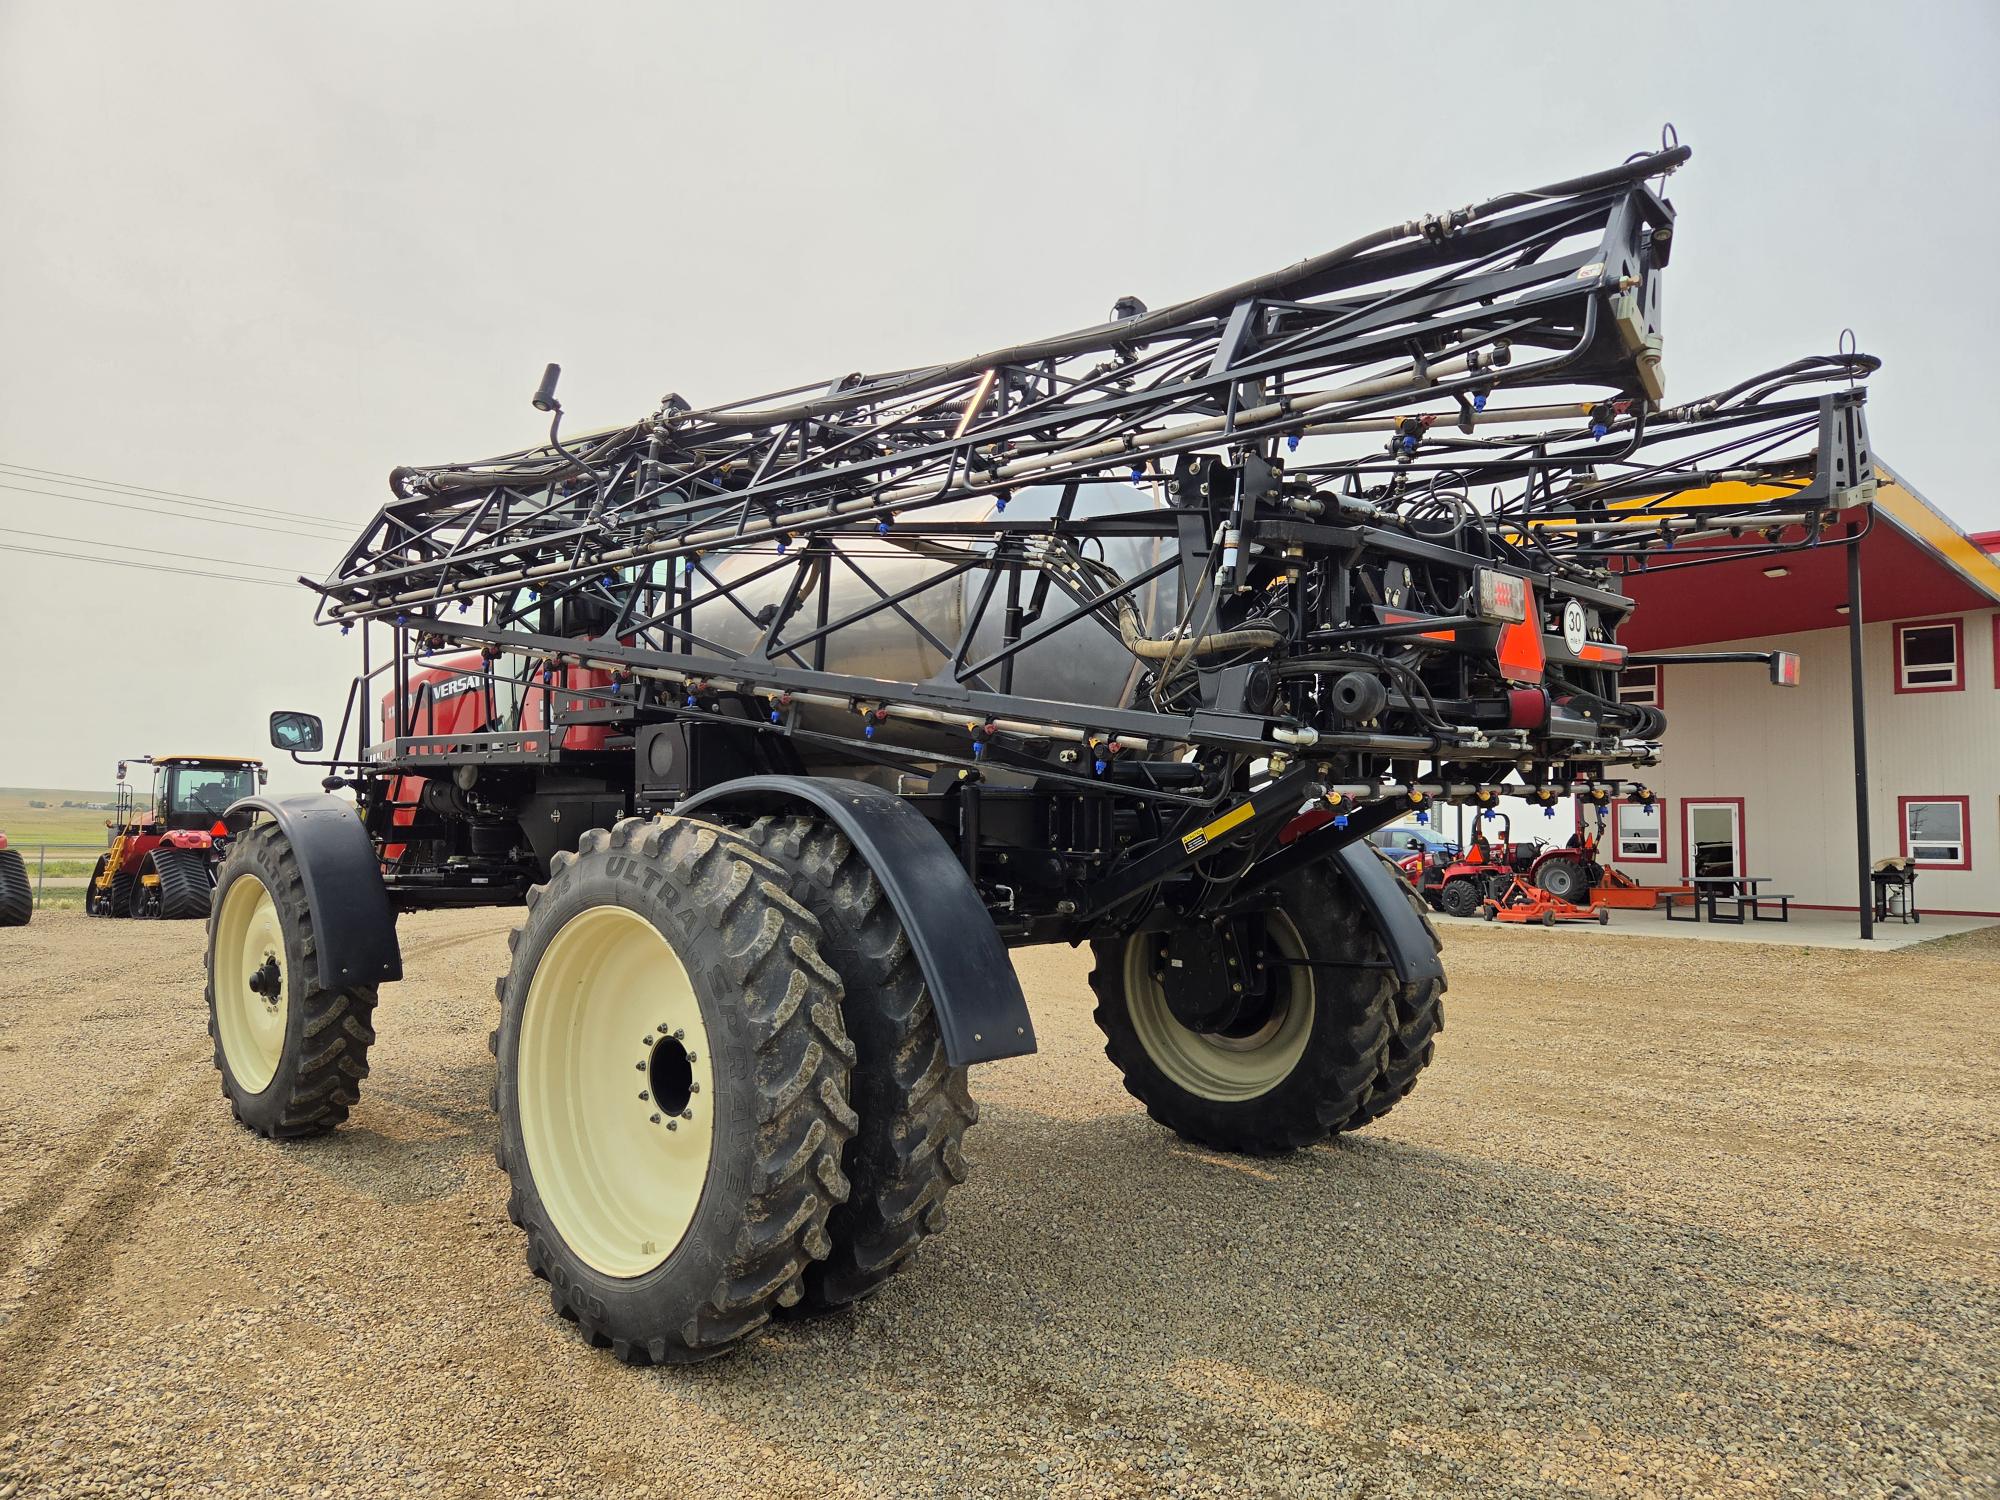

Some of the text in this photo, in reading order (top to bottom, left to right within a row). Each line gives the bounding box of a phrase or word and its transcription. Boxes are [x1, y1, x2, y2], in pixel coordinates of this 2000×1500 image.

[1569, 610, 1582, 633] 30
[432, 671, 493, 700] VERSAT
[256, 850, 291, 919] ULTRA
[605, 856, 748, 1236] ULTRA SPRAYER
